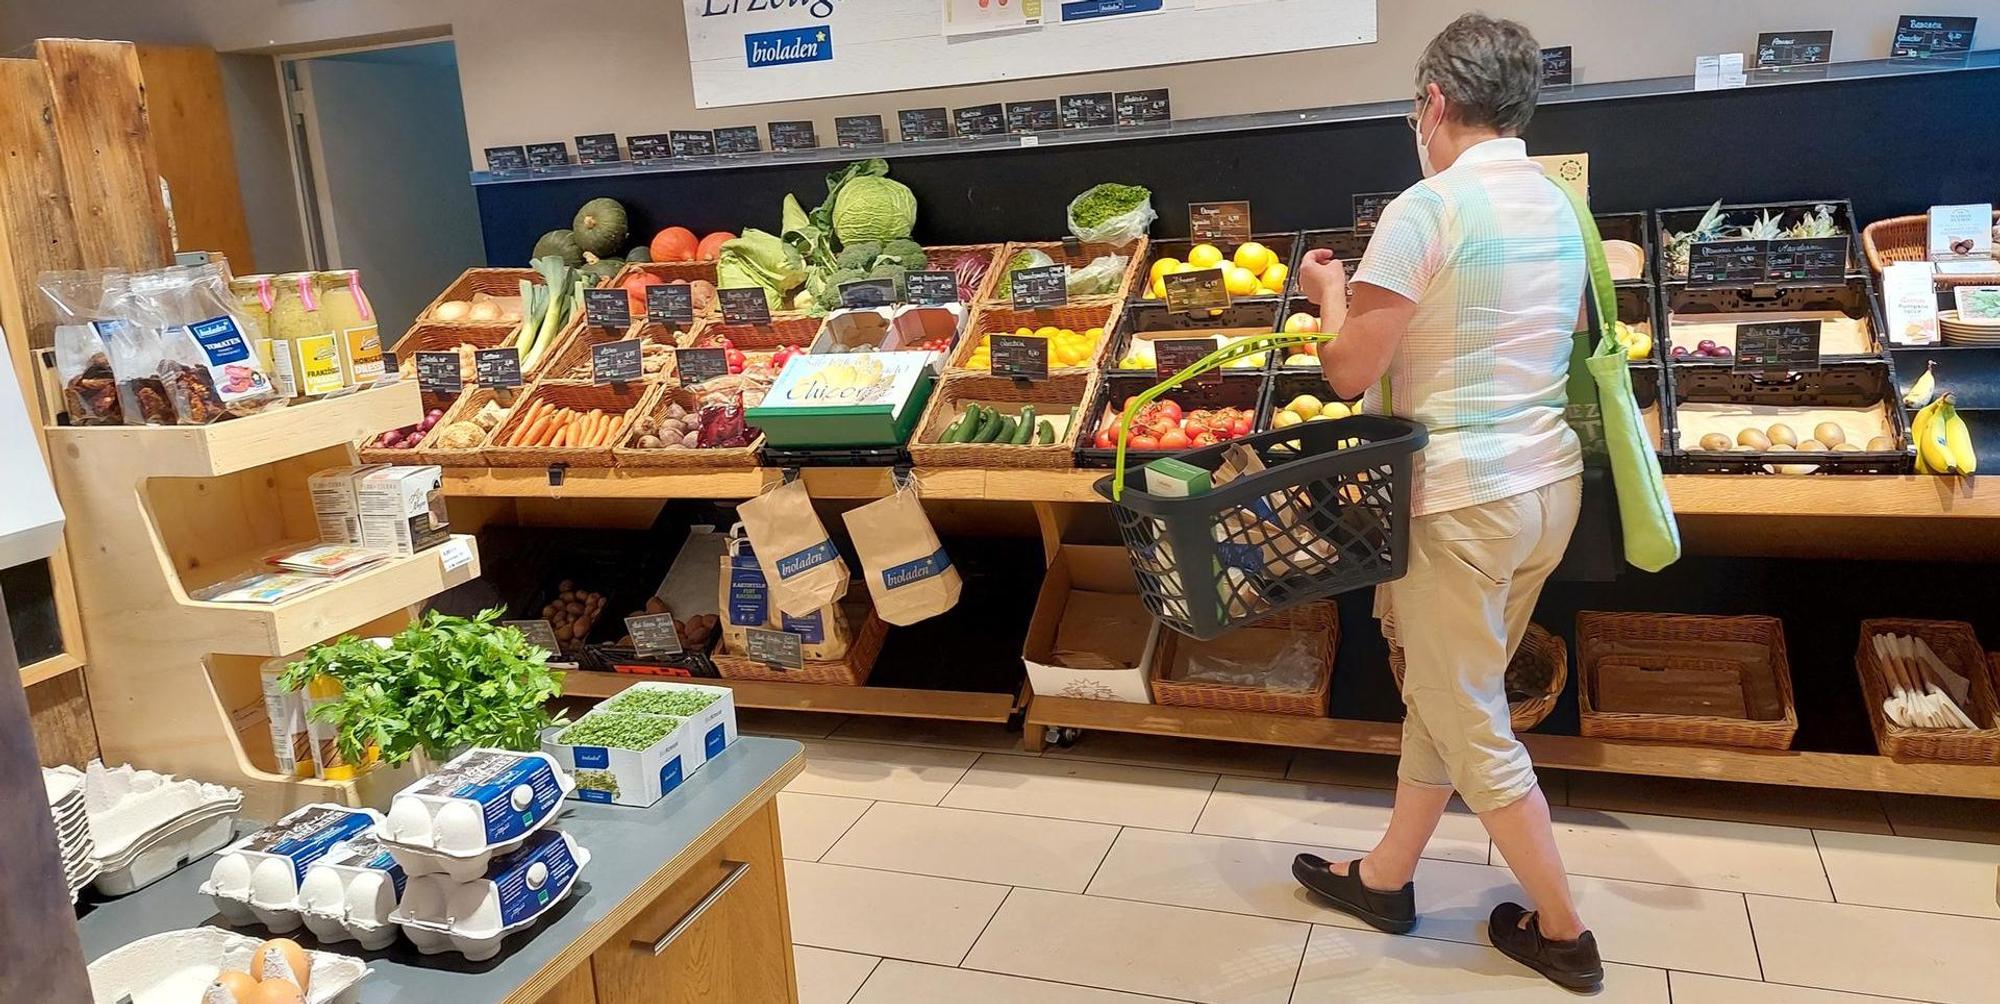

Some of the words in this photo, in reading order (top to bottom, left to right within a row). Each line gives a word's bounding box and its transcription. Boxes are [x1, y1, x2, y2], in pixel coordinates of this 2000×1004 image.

[752, 36, 818, 64] bioladen
[204, 337, 241, 350] TOMATEN
[781, 551, 823, 575] bioladen
[887, 565, 930, 586] bioladen
